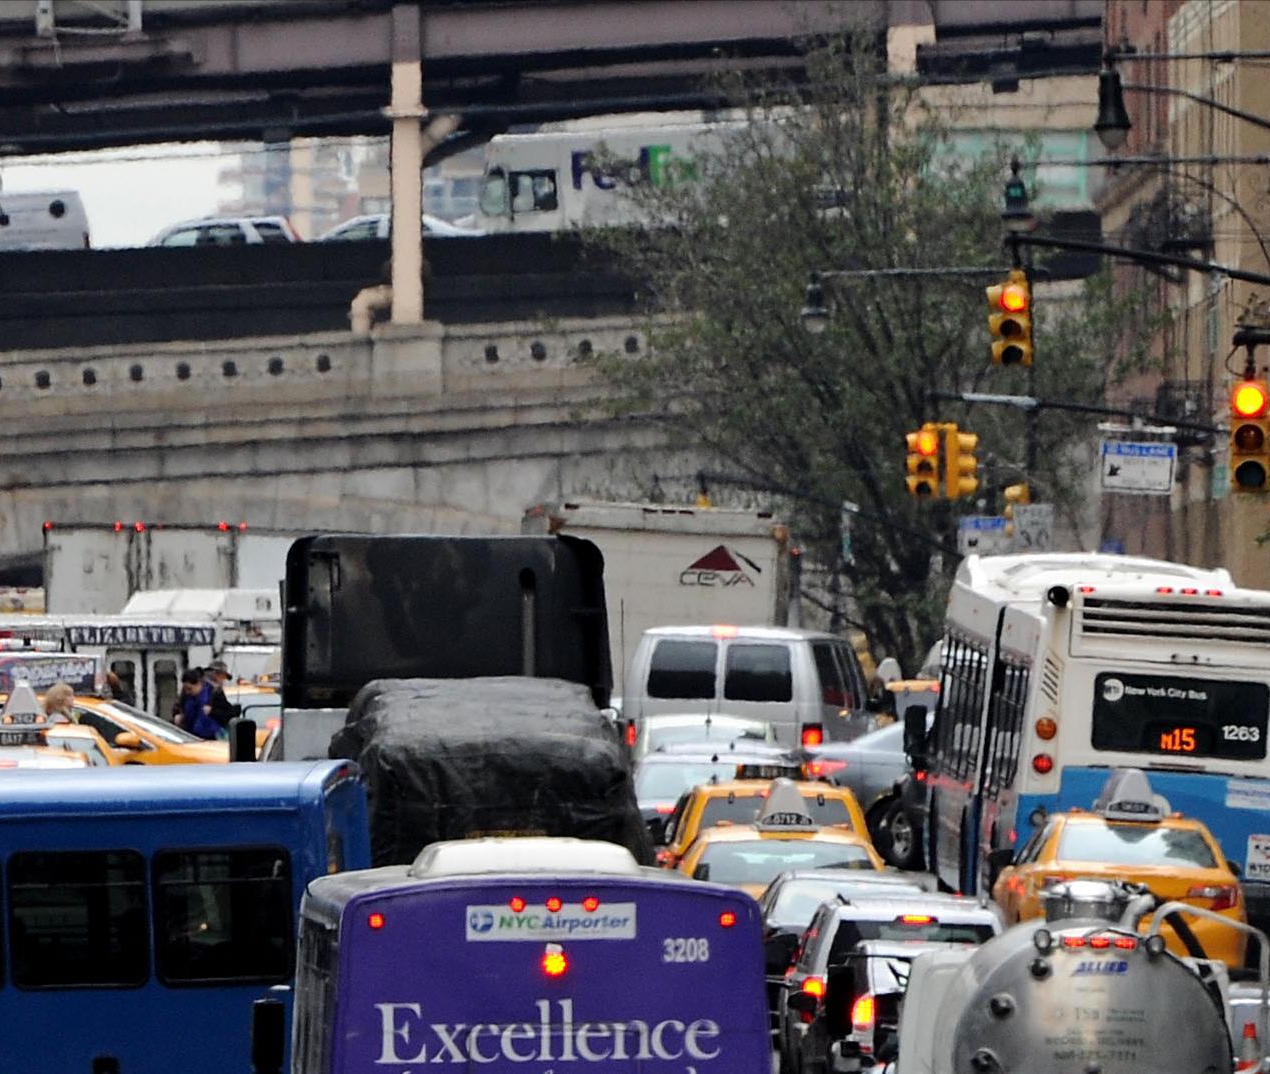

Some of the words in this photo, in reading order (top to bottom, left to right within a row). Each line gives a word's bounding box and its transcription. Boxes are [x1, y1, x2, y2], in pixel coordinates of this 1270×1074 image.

[1125, 686, 1146, 696] New
[1147, 687, 1166, 697] York
[1167, 689, 1187, 700] City
[1221, 725, 1261, 742] 1263
[498, 915, 540, 930] NYC
[542, 914, 629, 934] Airporter
[662, 938, 709, 963] 3208
[374, 998, 721, 1065] Excellence
